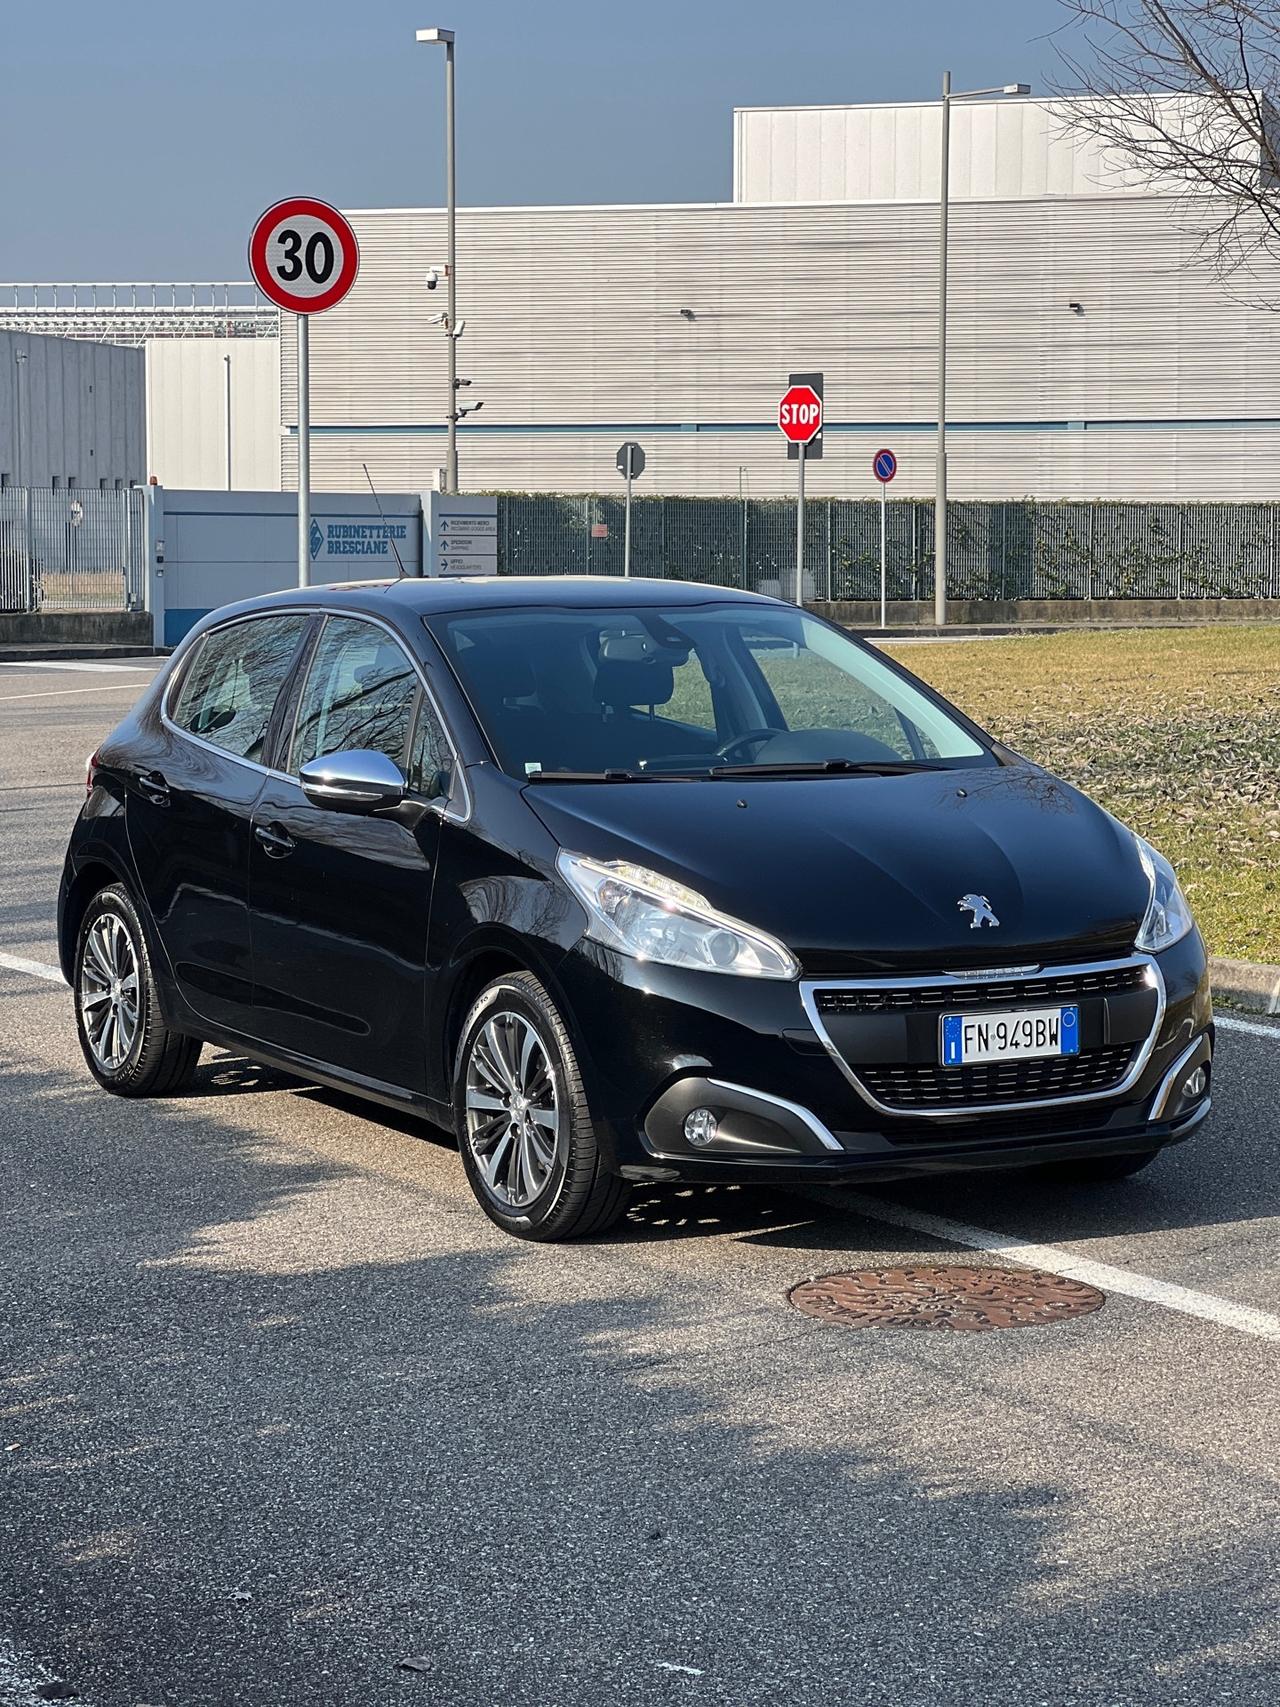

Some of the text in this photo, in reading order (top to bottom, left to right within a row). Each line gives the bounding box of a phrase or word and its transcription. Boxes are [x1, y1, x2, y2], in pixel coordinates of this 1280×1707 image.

[277, 229, 334, 284] 30
[781, 404, 819, 424] STOP
[327, 525, 407, 539] RUBINETTERIE
[327, 540, 388, 555] BRESCIANE
